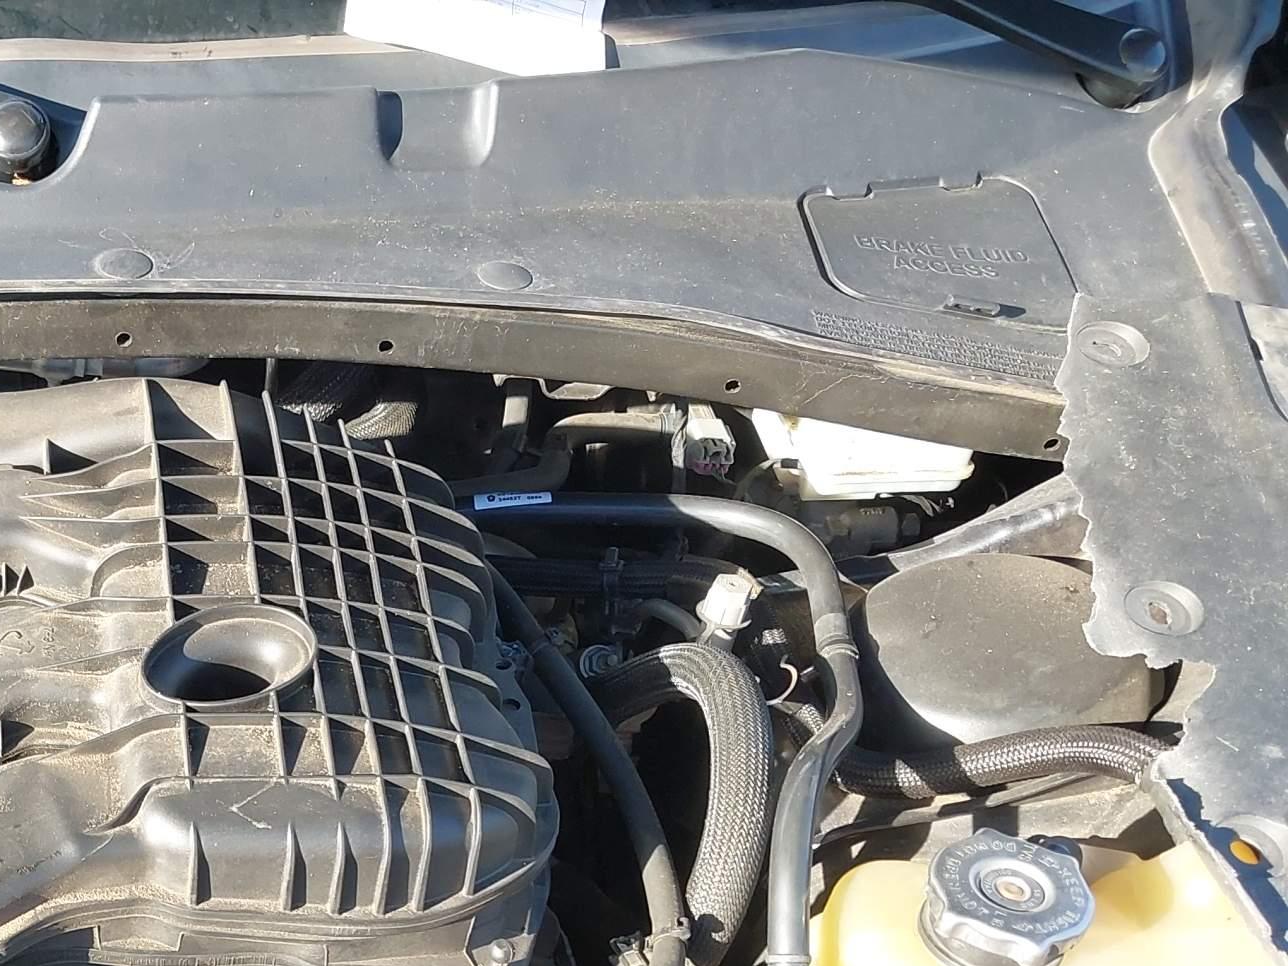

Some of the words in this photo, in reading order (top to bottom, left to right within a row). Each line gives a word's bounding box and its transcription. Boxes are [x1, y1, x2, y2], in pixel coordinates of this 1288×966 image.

[853, 234, 944, 258] BRAKE
[949, 244, 1030, 263] FLUID
[894, 256, 1000, 279] ACCESS
